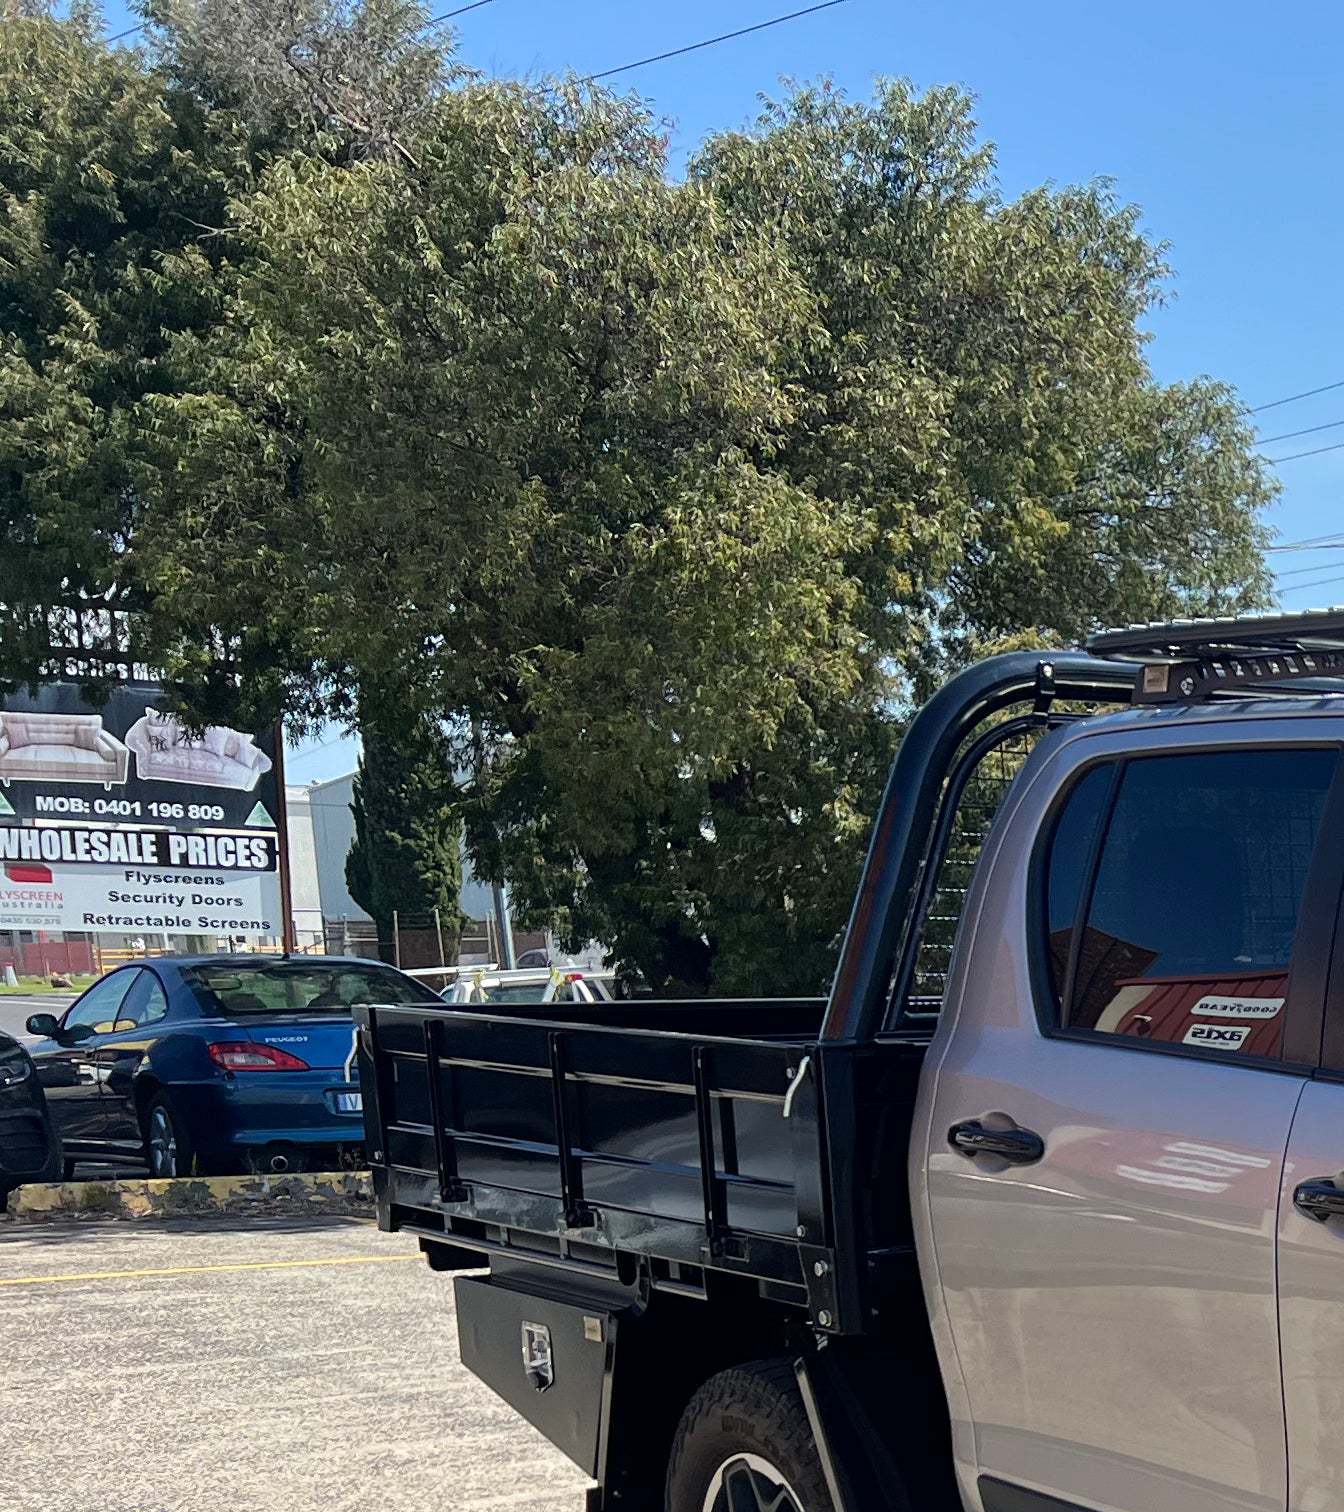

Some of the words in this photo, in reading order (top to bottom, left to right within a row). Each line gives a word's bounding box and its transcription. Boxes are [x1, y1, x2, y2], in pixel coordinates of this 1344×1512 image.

[35, 796, 90, 813] MOB:
[94, 799, 141, 816] 0401
[148, 802, 184, 819] 196
[188, 804, 225, 820] 809
[0, 828, 158, 864] WHOLESALE
[169, 835, 269, 868] PRICES
[125, 870, 225, 886] Flyscreens
[108, 890, 185, 907] Security
[191, 894, 244, 907] Doors
[83, 912, 192, 928] Retractable
[198, 916, 271, 930] Screens
